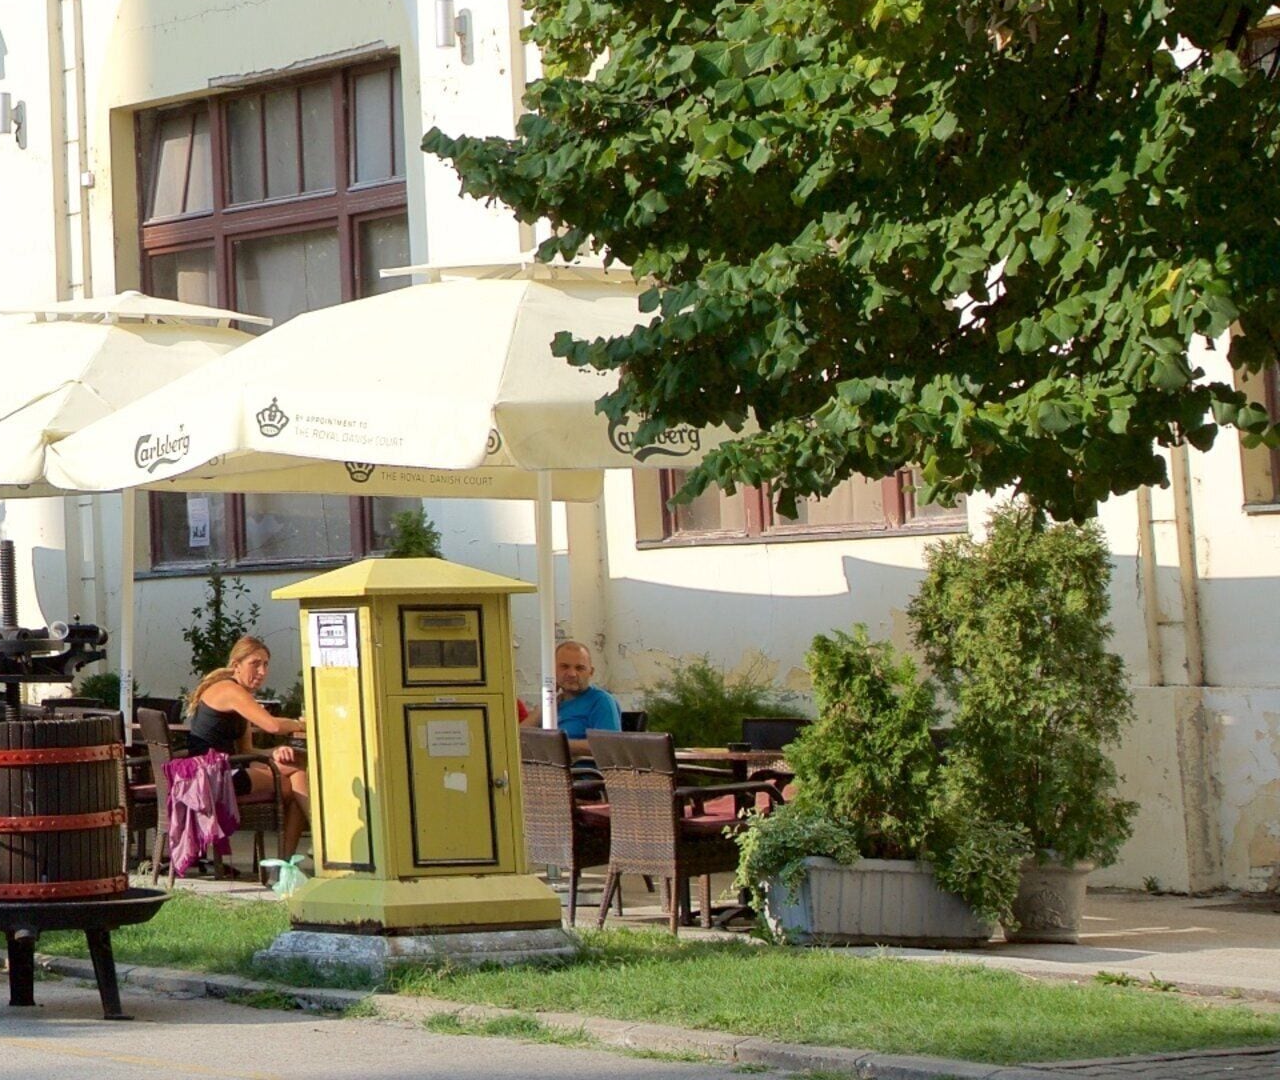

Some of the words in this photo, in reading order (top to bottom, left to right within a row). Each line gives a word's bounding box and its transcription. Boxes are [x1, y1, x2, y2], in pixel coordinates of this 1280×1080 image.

[306, 415, 357, 428] APPOINTMENT
[295, 426, 309, 438] THE
[312, 428, 340, 442] ROYAL
[134, 432, 191, 469] Carlsberg
[381, 471, 397, 481] THE
[400, 472, 426, 483] ROYAL
[430, 473, 461, 485] DANISH
[463, 475, 493, 486] COURT
